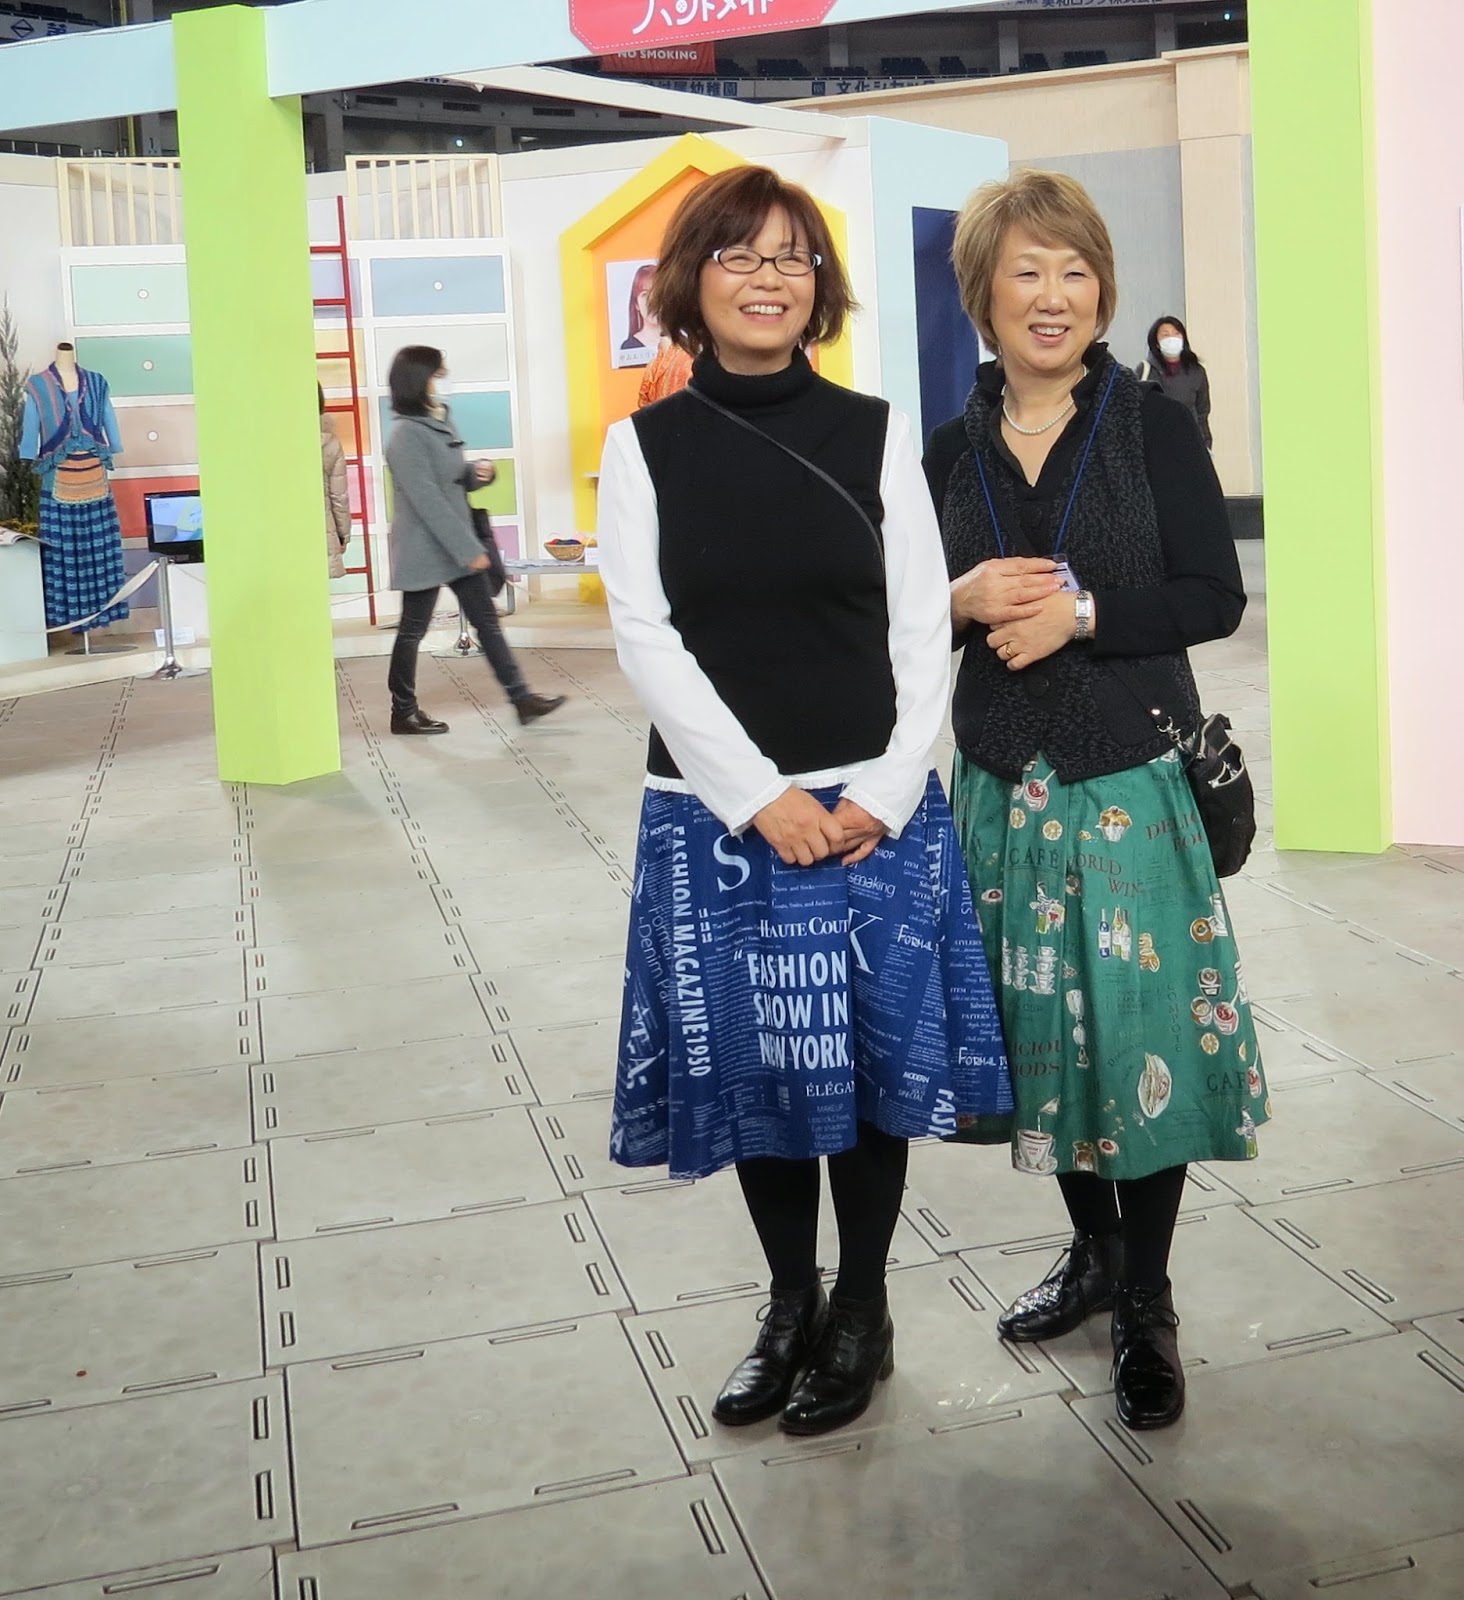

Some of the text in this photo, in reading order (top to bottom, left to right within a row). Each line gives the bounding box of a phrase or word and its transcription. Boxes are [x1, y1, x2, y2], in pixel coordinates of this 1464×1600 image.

[617, 50, 698, 61] NO SMOKING
[753, 992, 813, 1029] SHOW
[822, 991, 849, 1027] IN
[758, 1032, 786, 1069] NEW
